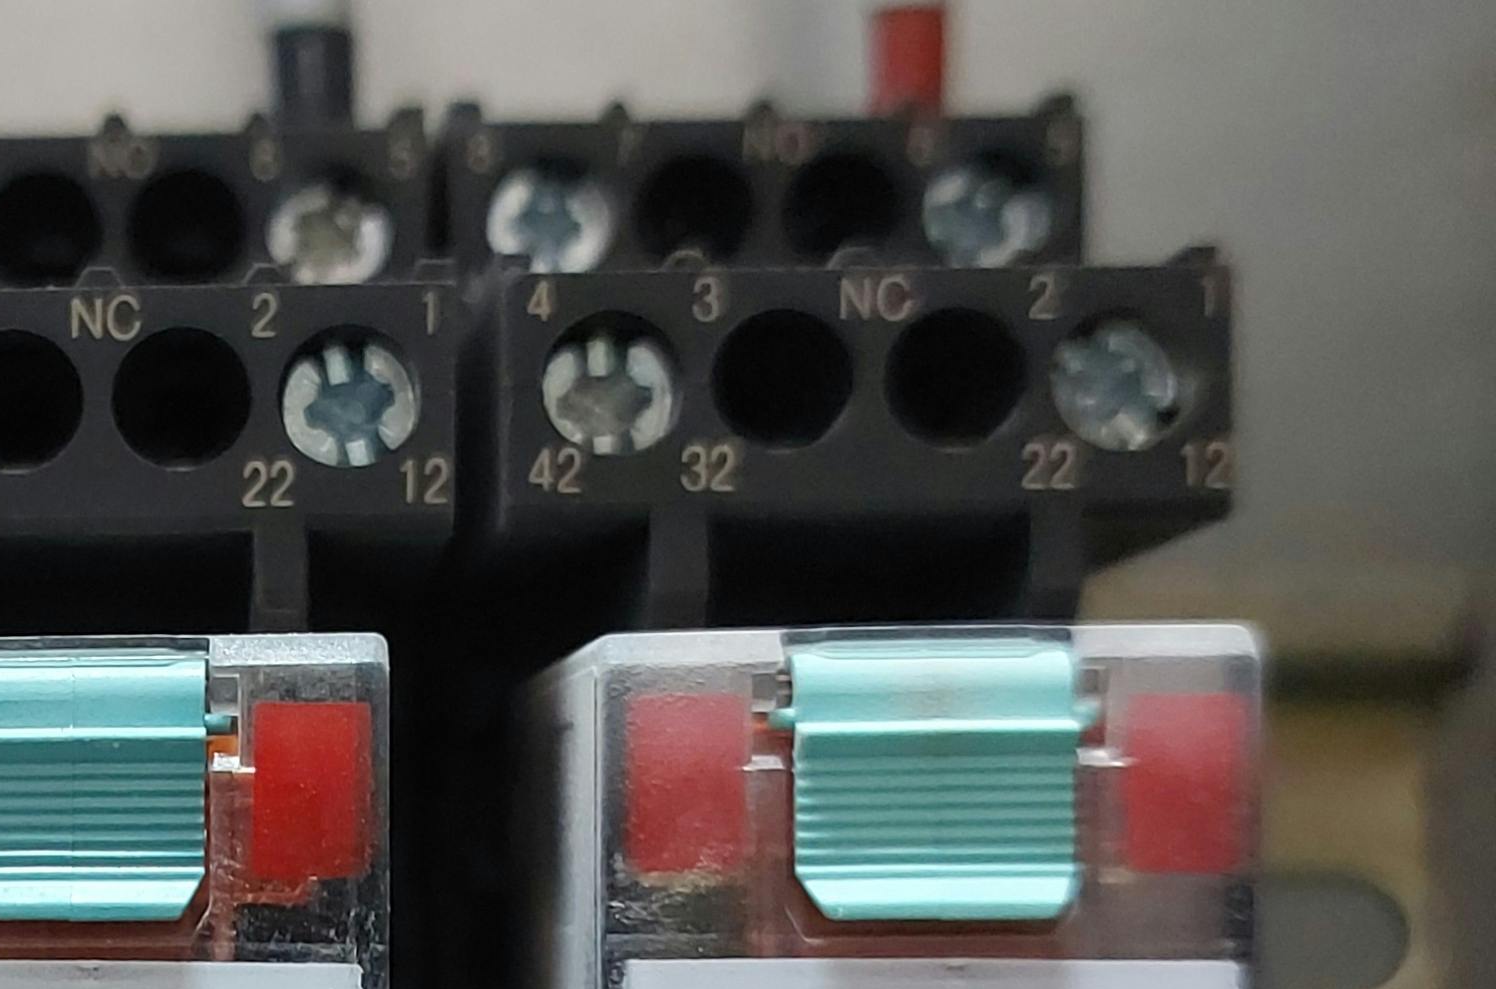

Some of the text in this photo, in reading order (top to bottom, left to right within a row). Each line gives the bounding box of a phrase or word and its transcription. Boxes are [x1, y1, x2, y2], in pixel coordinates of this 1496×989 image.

[70, 296, 142, 340] NC
[252, 294, 278, 337] 2
[423, 294, 436, 334] 1
[527, 279, 552, 320] 4
[692, 277, 722, 320] 3
[839, 277, 913, 320] NC
[1028, 275, 1058, 320] 2
[242, 461, 295, 507] 22
[401, 461, 450, 505] 12
[529, 442, 1234, 494] 42 32 22 12
